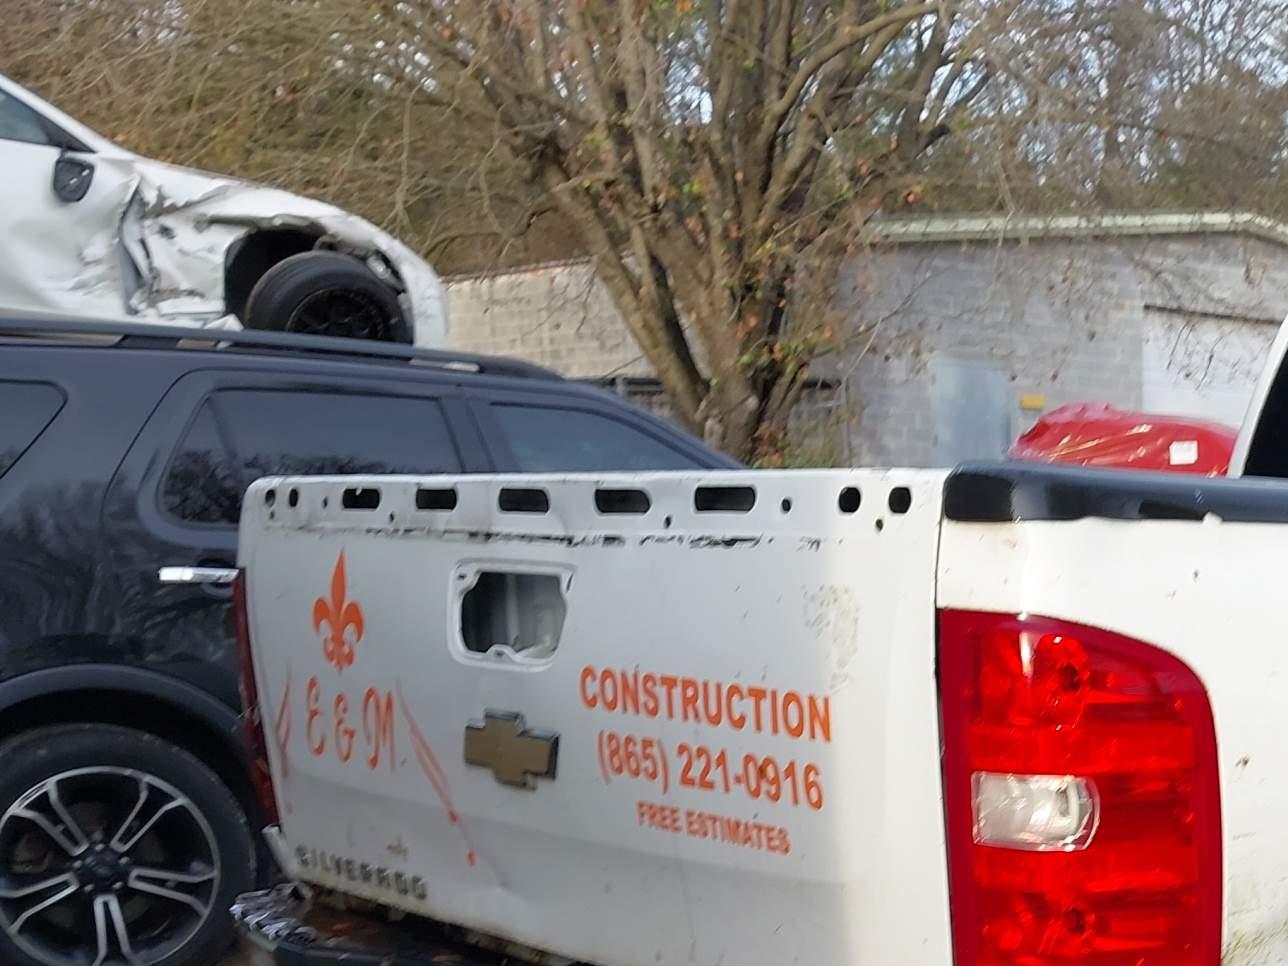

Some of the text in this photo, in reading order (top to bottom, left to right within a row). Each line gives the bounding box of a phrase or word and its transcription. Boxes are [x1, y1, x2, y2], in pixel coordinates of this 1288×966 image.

[579, 664, 833, 743] CONSTRUCTION
[598, 729, 823, 811] (865) 221-0916
[637, 800, 792, 855] FREE ESTIMATES
